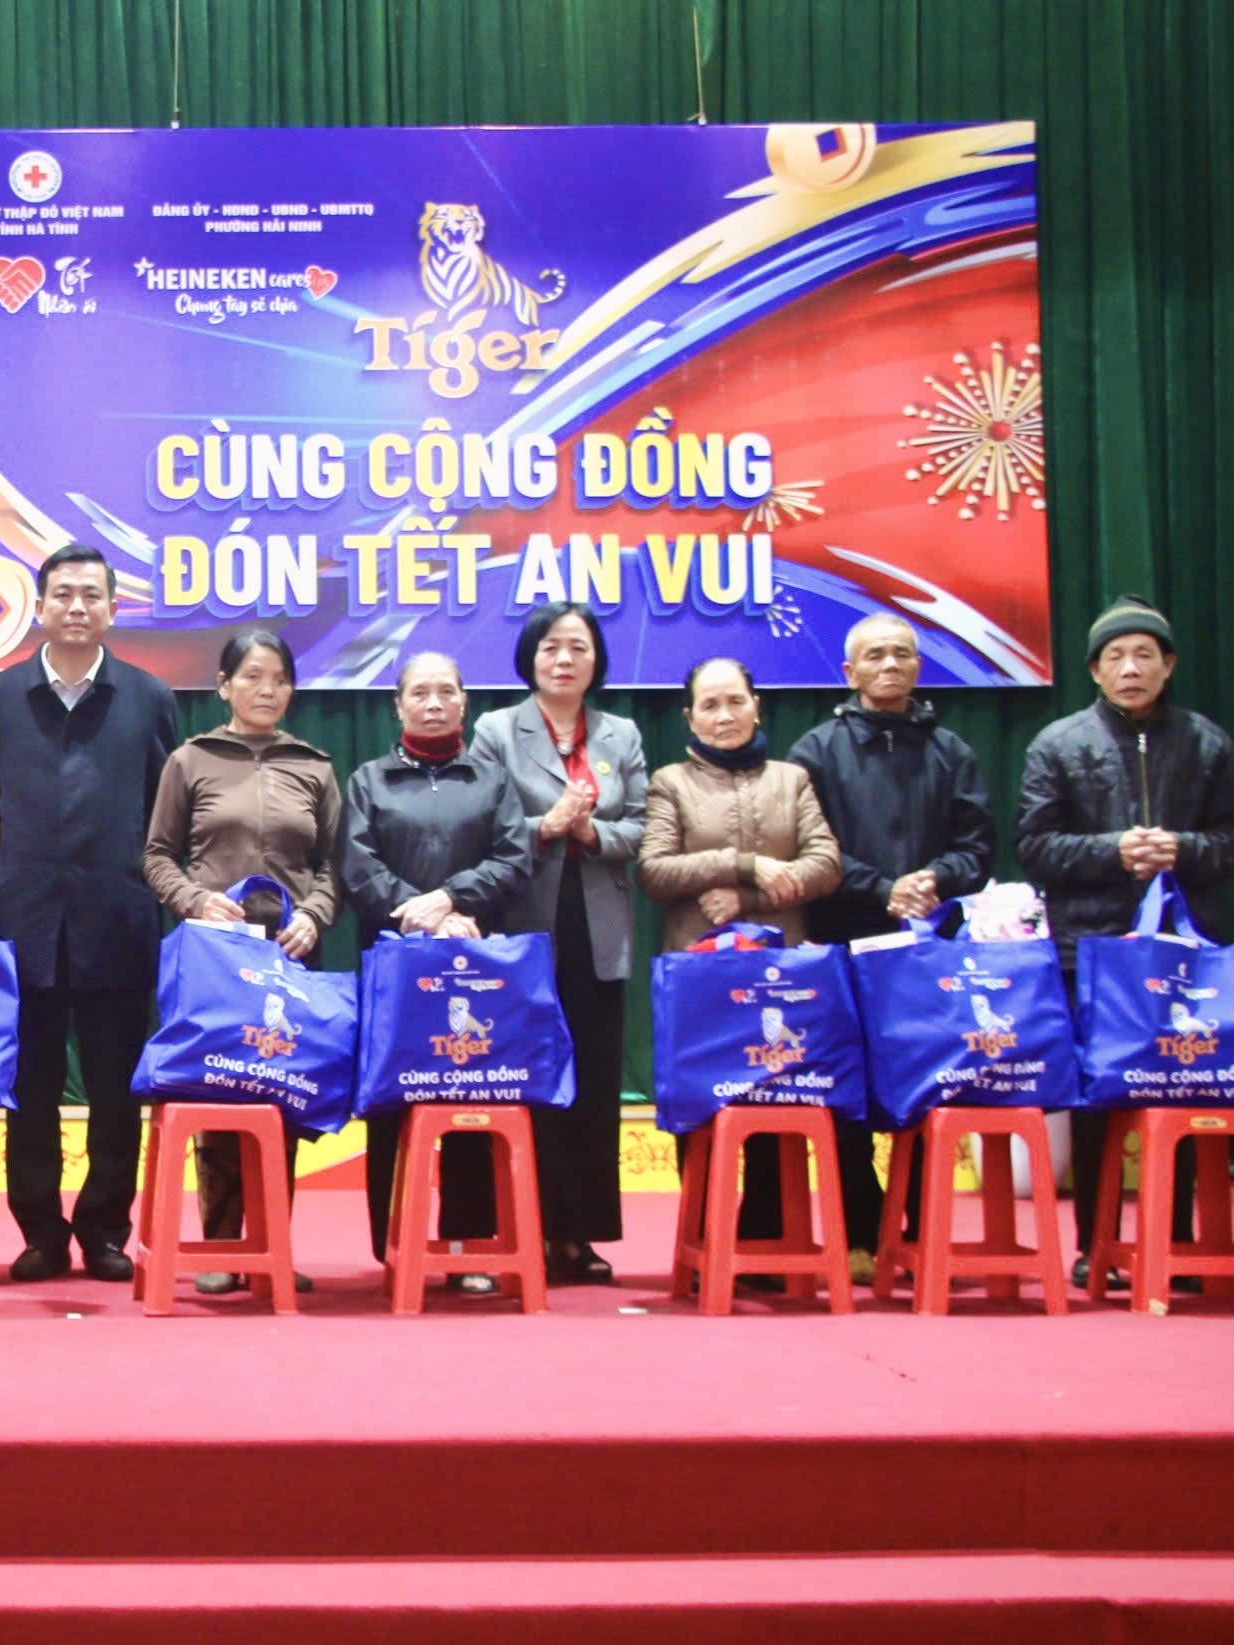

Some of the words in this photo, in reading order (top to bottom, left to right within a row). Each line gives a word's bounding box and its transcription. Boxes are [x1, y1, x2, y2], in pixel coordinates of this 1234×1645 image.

[62, 205, 89, 221] VIỆT
[92, 206, 124, 218] NAM
[288, 220, 322, 232] NINH
[147, 268, 267, 290] HEINEKEN
[175, 294, 226, 324] Chung
[222, 295, 248, 317] tay
[269, 296, 298, 315] chia
[354, 309, 561, 399] Tiger
[157, 418, 346, 500] CÙNG
[369, 416, 558, 513] CỘNG
[581, 406, 773, 498] ĐỒNG
[160, 517, 318, 606] ĐÓN
[343, 516, 492, 605] TẾT
[515, 533, 621, 604] AN
[646, 533, 774, 604] VUI
[429, 1032, 493, 1065] Tiger
[1155, 1033, 1220, 1065] Tiger
[204, 1053, 245, 1073] CÙNG
[247, 1063, 286, 1082] CỘNG
[398, 1068, 440, 1085] CÙNG
[443, 1069, 484, 1087] CỘNG
[1123, 1068, 1167, 1084] CÙNG
[1170, 1068, 1214, 1085] CỘNG
[204, 1072, 236, 1088] ĐÓN
[469, 1089, 490, 1100] AN
[493, 1088, 521, 1100] VUI
[775, 1092, 797, 1103] AN
